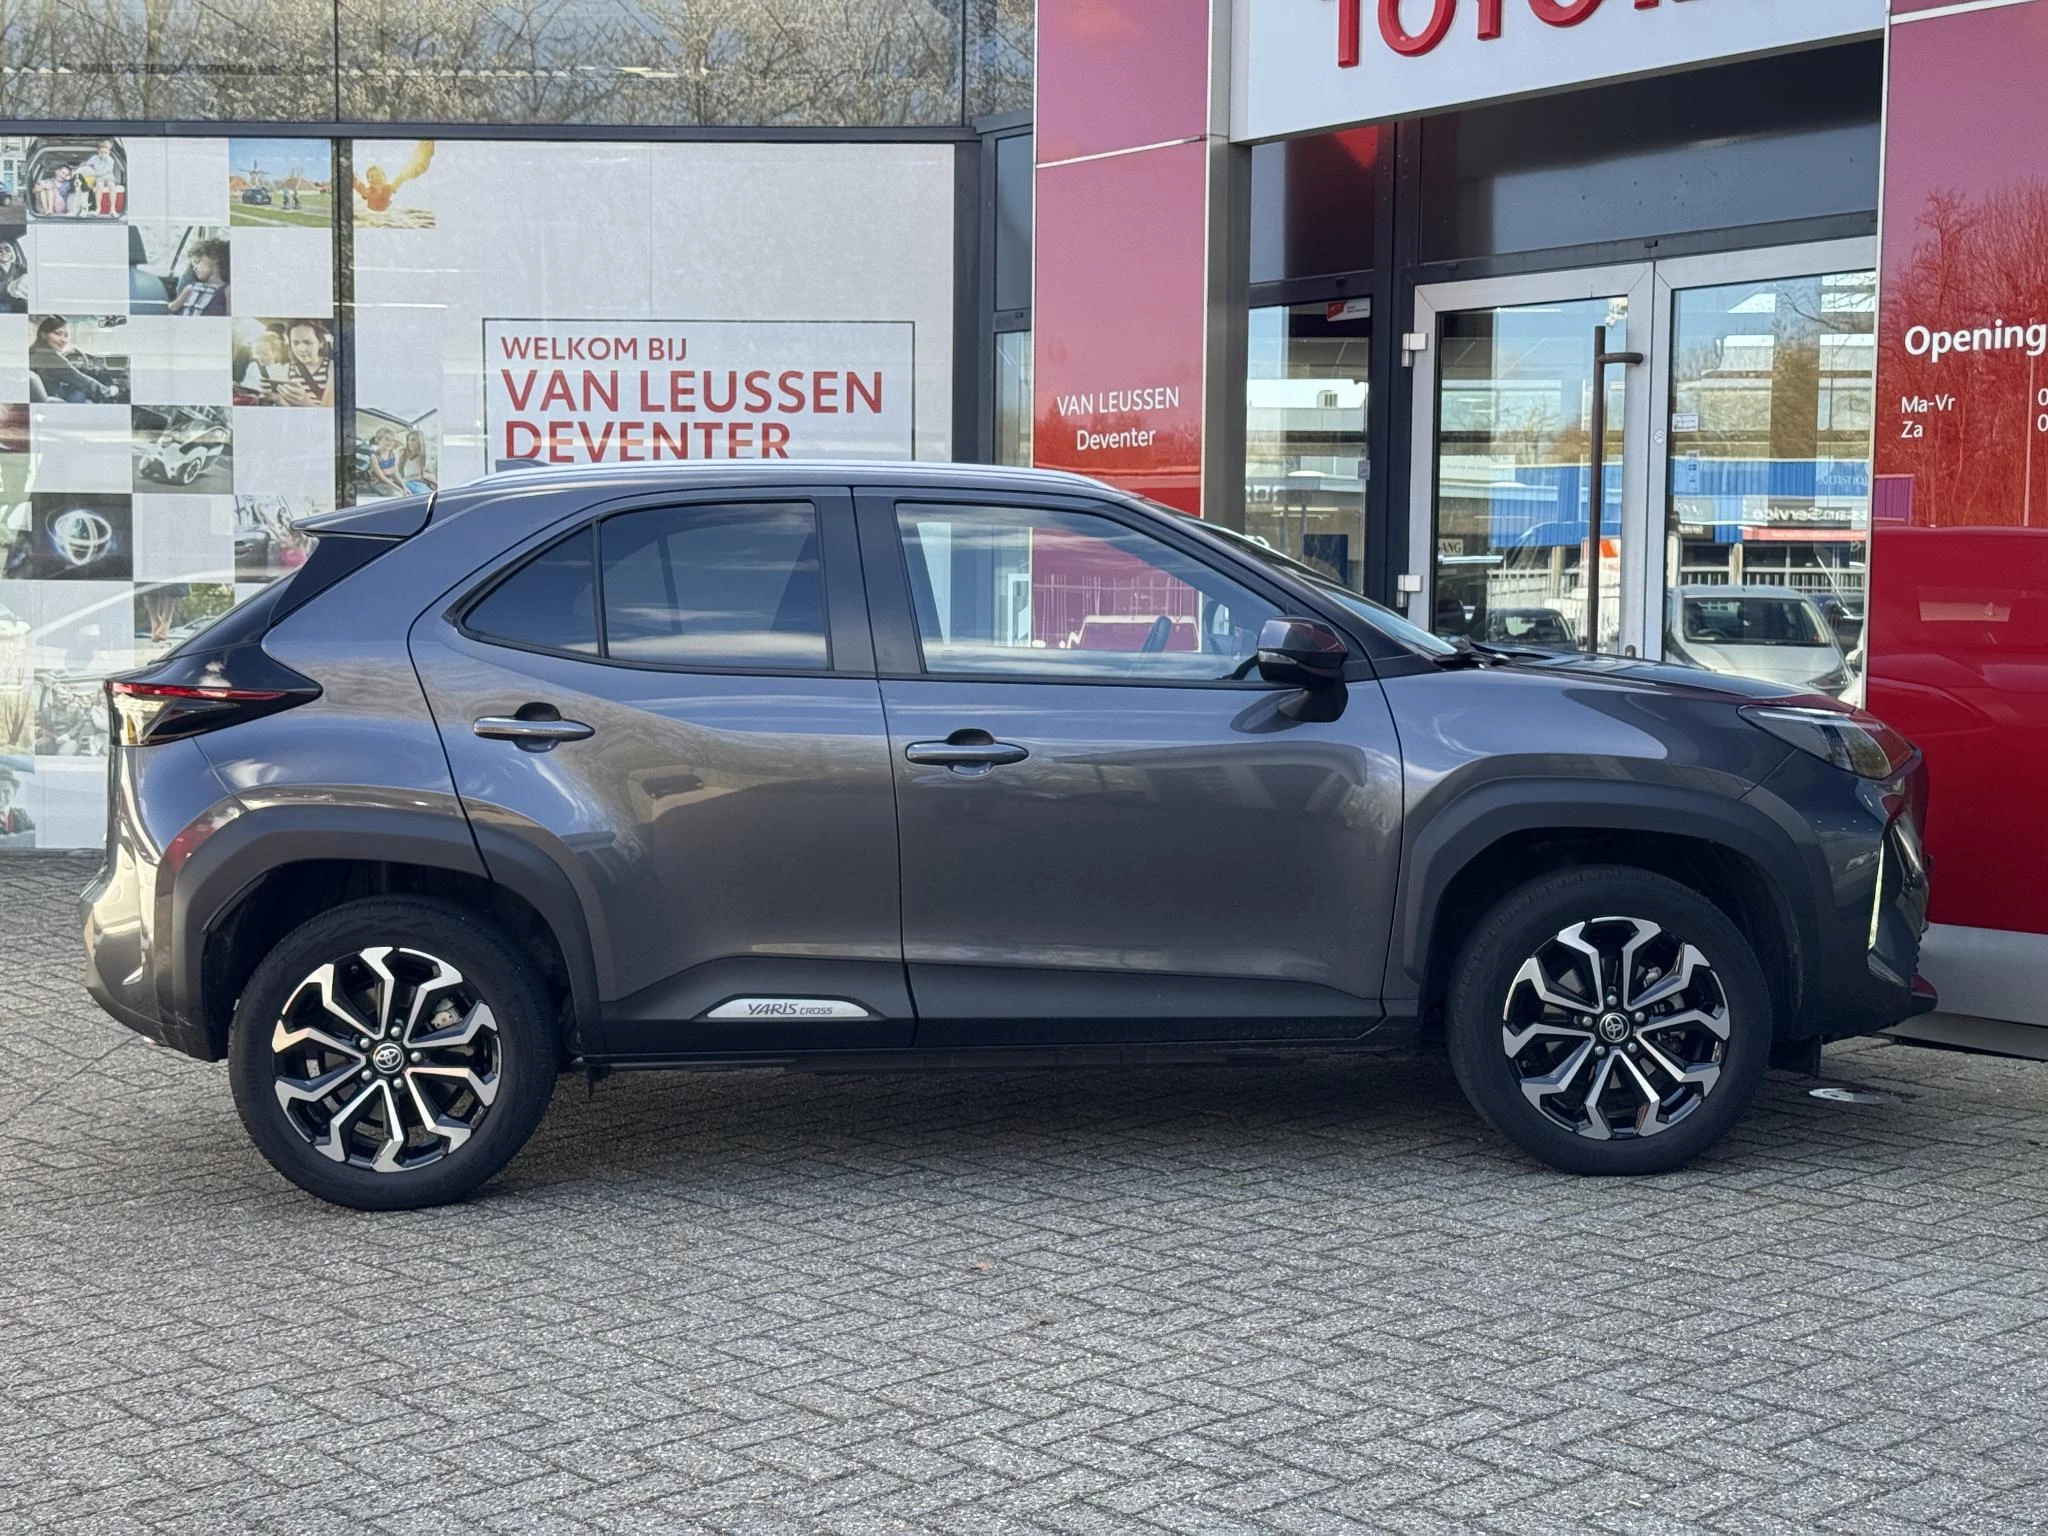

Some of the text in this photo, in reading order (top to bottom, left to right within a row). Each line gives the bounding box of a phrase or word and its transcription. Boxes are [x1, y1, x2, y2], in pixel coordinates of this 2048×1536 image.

[501, 336, 687, 361] WELKOM BIJ
[1904, 318, 2048, 363] Opening
[501, 369, 883, 414] VAN LEUSSEN
[1056, 386, 1180, 417] VAN LEUSSEN
[1901, 393, 1956, 413] Ma-Vr
[506, 421, 791, 463] DEVENTER
[1076, 427, 1157, 451] Deventer
[1901, 420, 1924, 439] Za
[748, 1002, 833, 1015] YARIS CROSS
